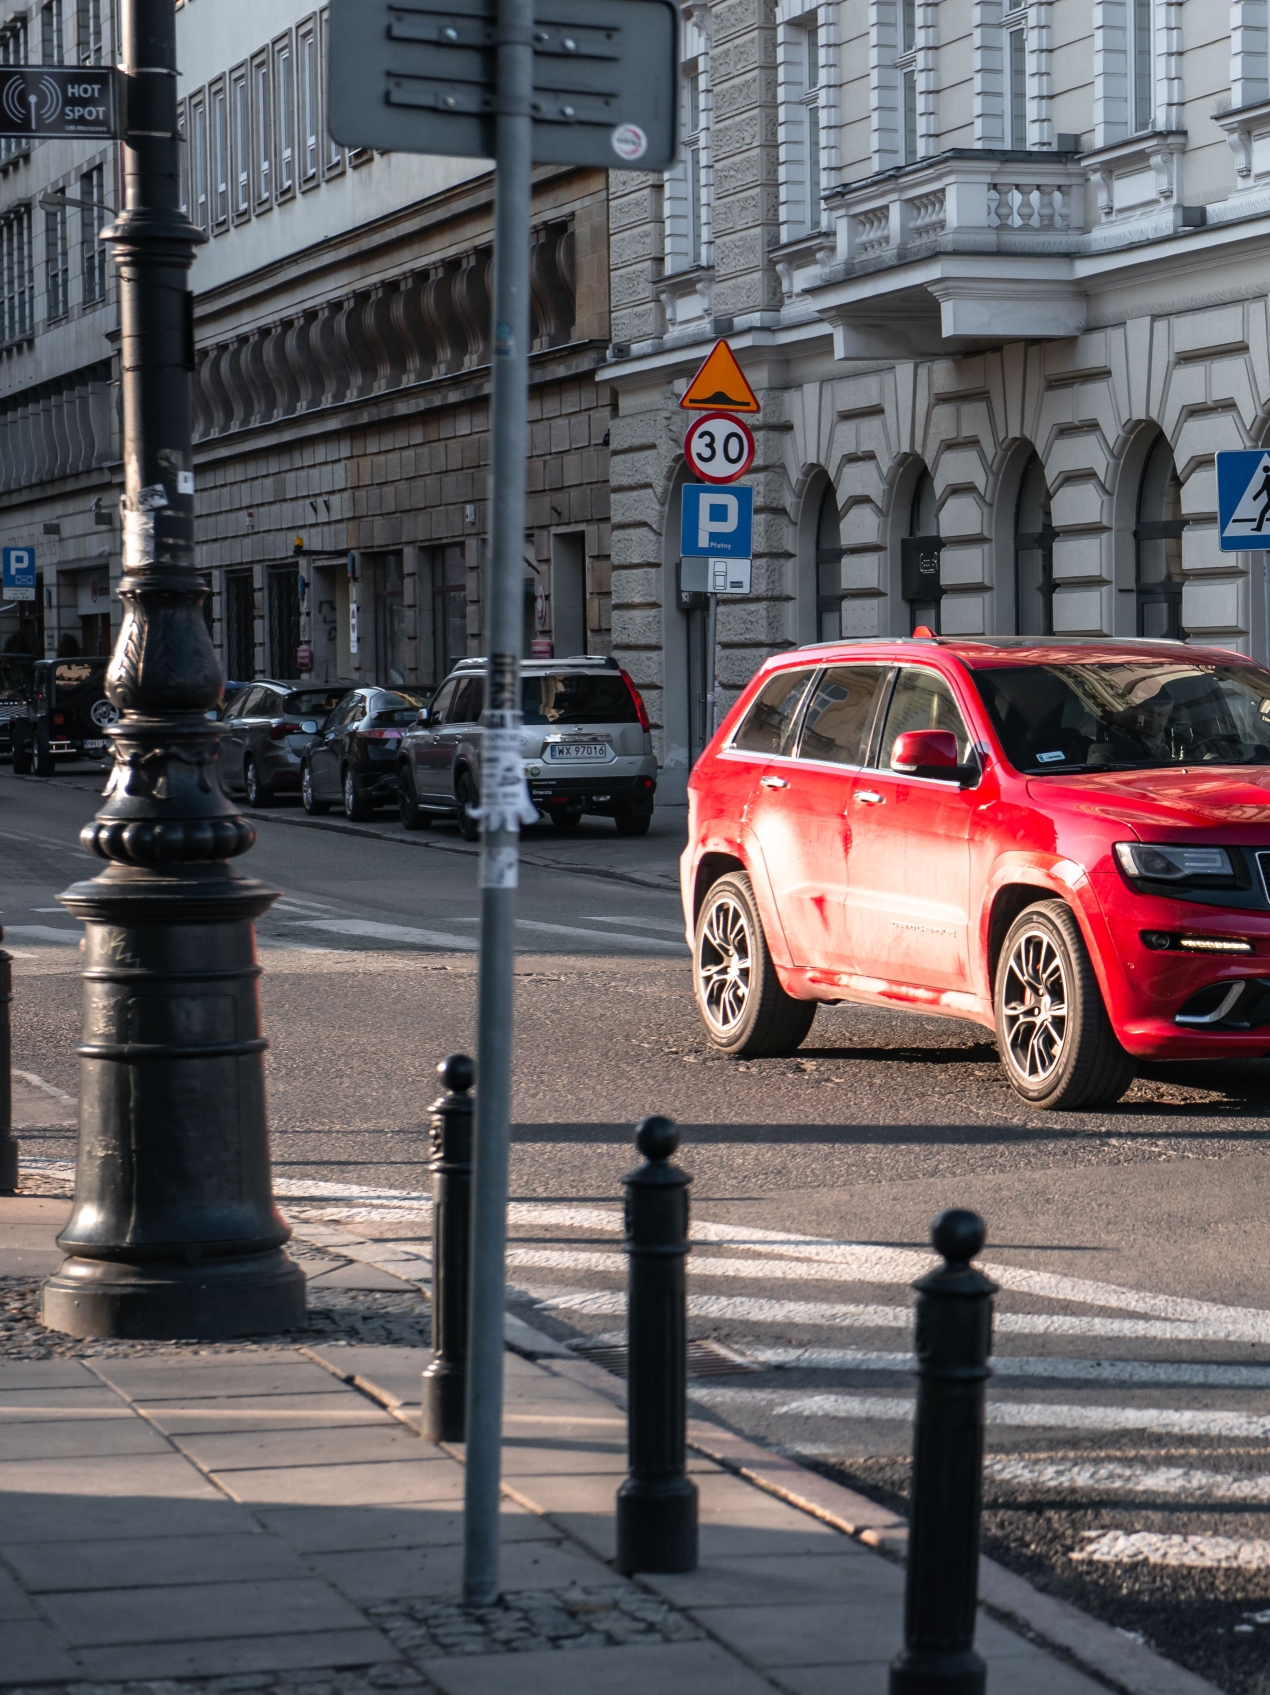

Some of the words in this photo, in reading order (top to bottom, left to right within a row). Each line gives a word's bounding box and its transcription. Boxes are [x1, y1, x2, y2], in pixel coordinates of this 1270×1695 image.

[67, 85, 101, 98] HOT
[64, 106, 106, 120] SPOT
[696, 430, 745, 465] 30
[698, 493, 739, 548] P
[709, 541, 732, 550] Płatny
[10, 550, 29, 576] P
[557, 746, 572, 756] WX
[574, 745, 604, 756] 97016
